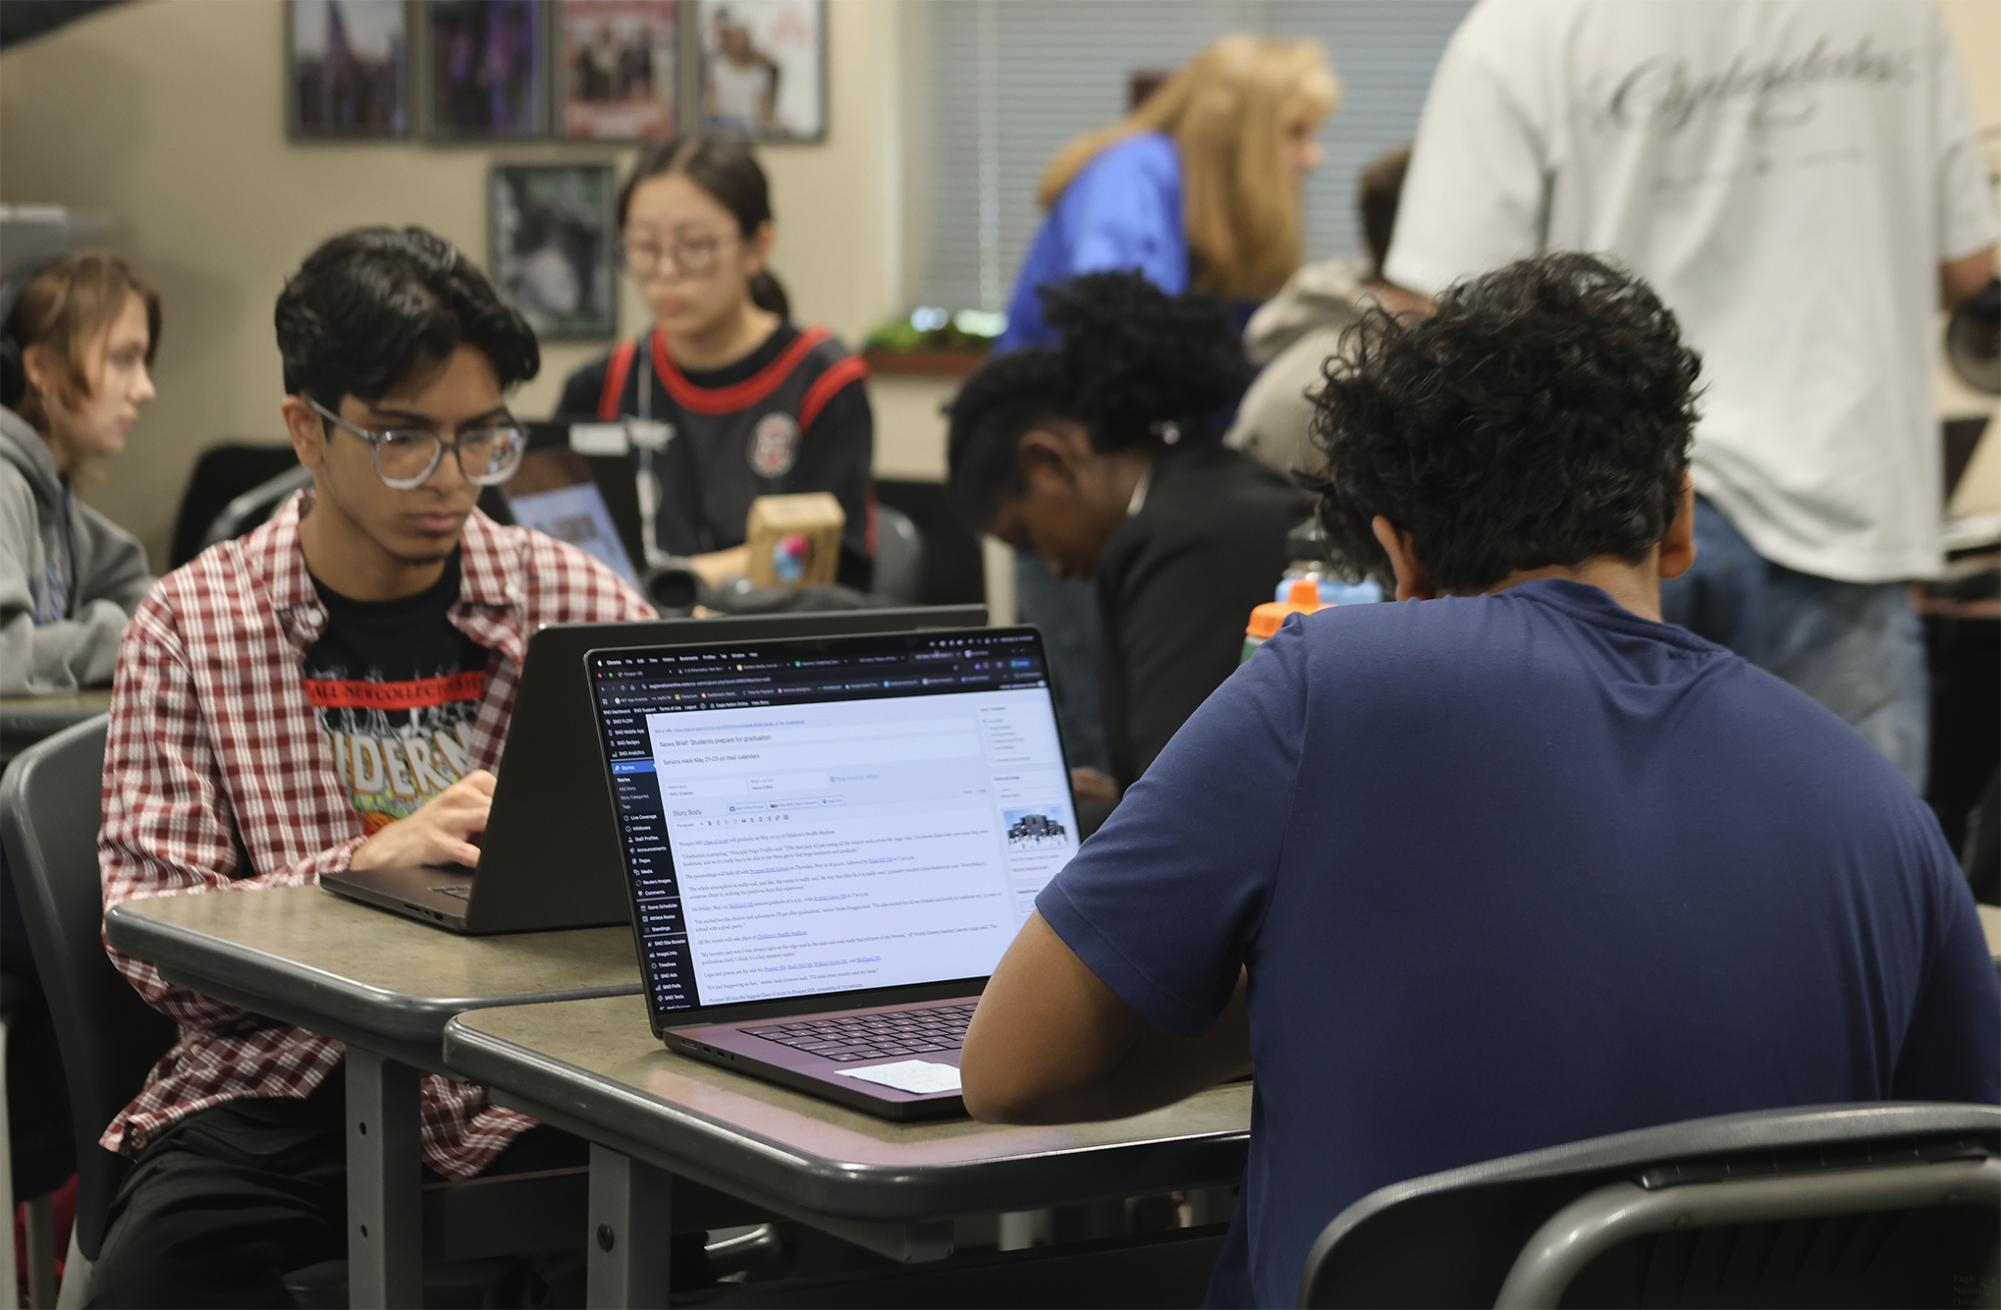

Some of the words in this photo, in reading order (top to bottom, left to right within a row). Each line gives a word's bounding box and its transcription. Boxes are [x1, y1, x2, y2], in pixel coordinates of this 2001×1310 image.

[659, 740, 675, 748] News
[690, 738, 713, 746] Students
[742, 734, 771, 743] graduation
[672, 808, 688, 818] Story
[687, 807, 702, 816] Body
